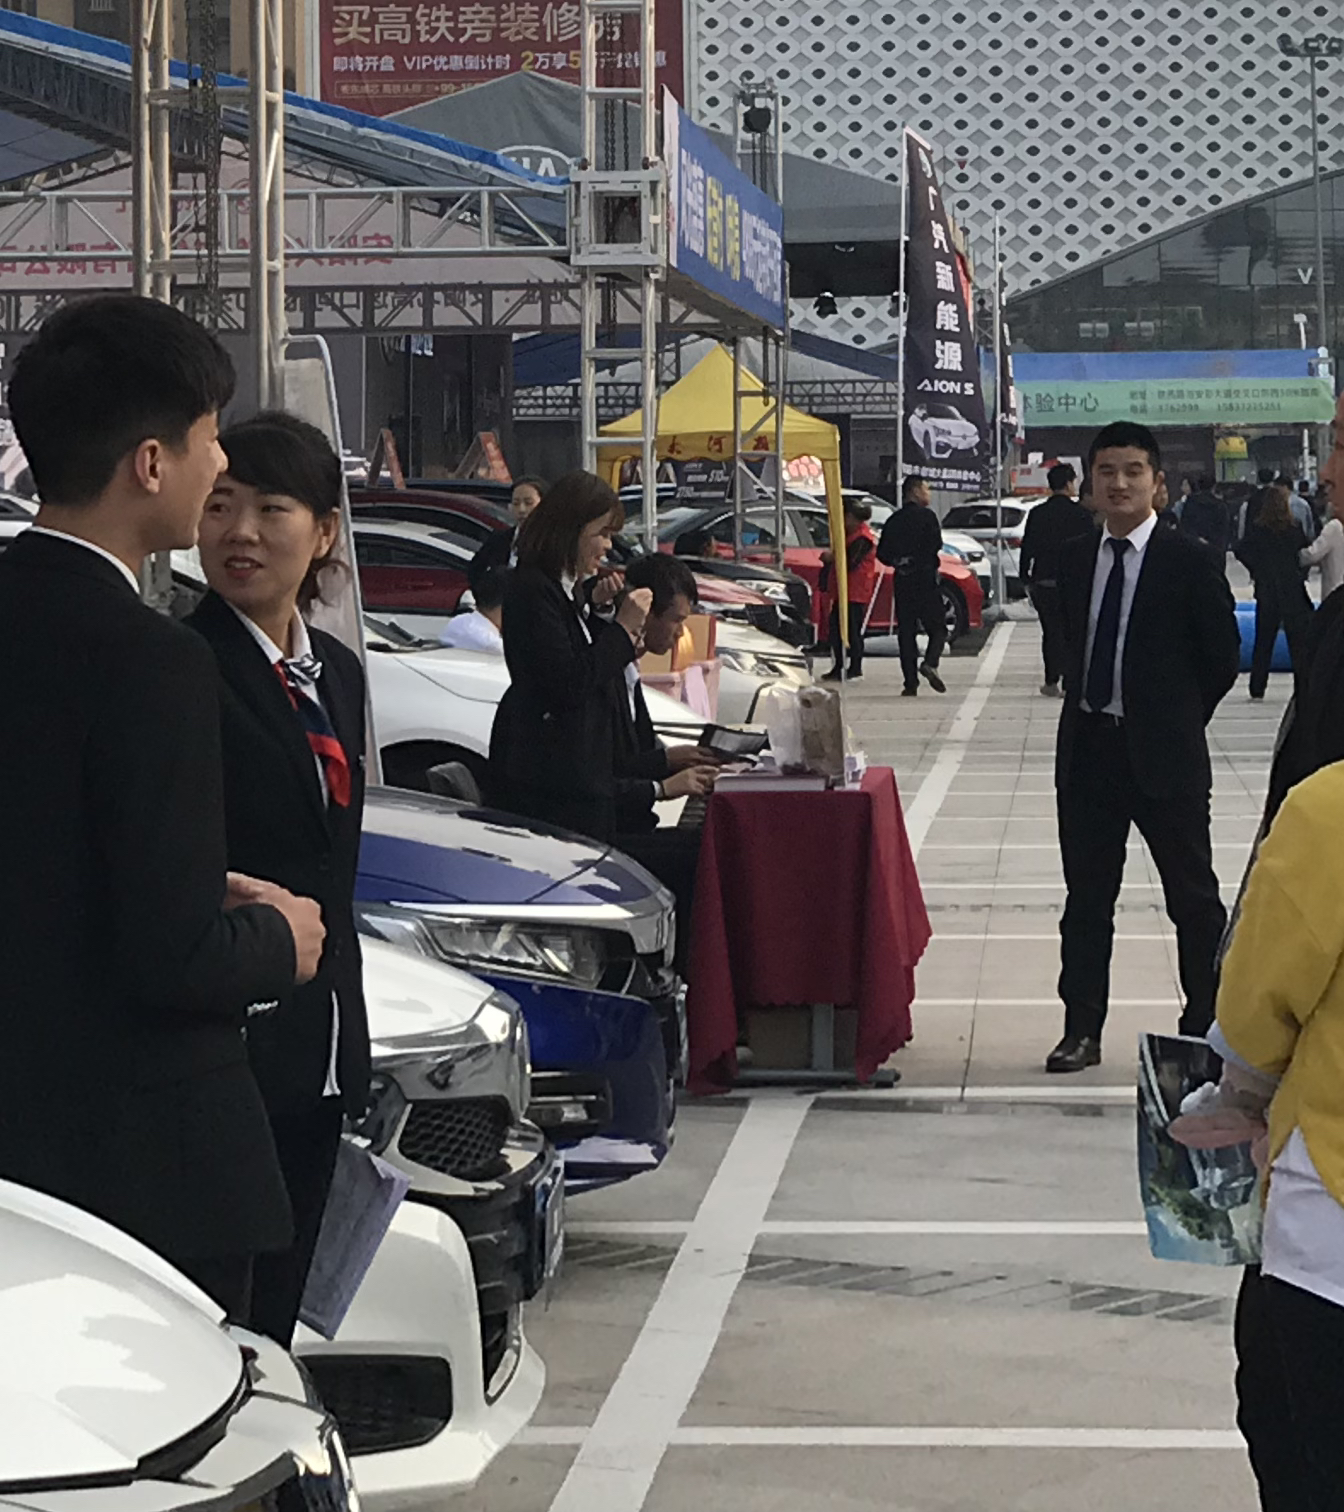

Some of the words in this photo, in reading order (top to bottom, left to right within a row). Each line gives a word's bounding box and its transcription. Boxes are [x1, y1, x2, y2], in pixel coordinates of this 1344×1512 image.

[928, 185, 964, 373] 广汽新能源
[917, 379, 962, 395] AION
